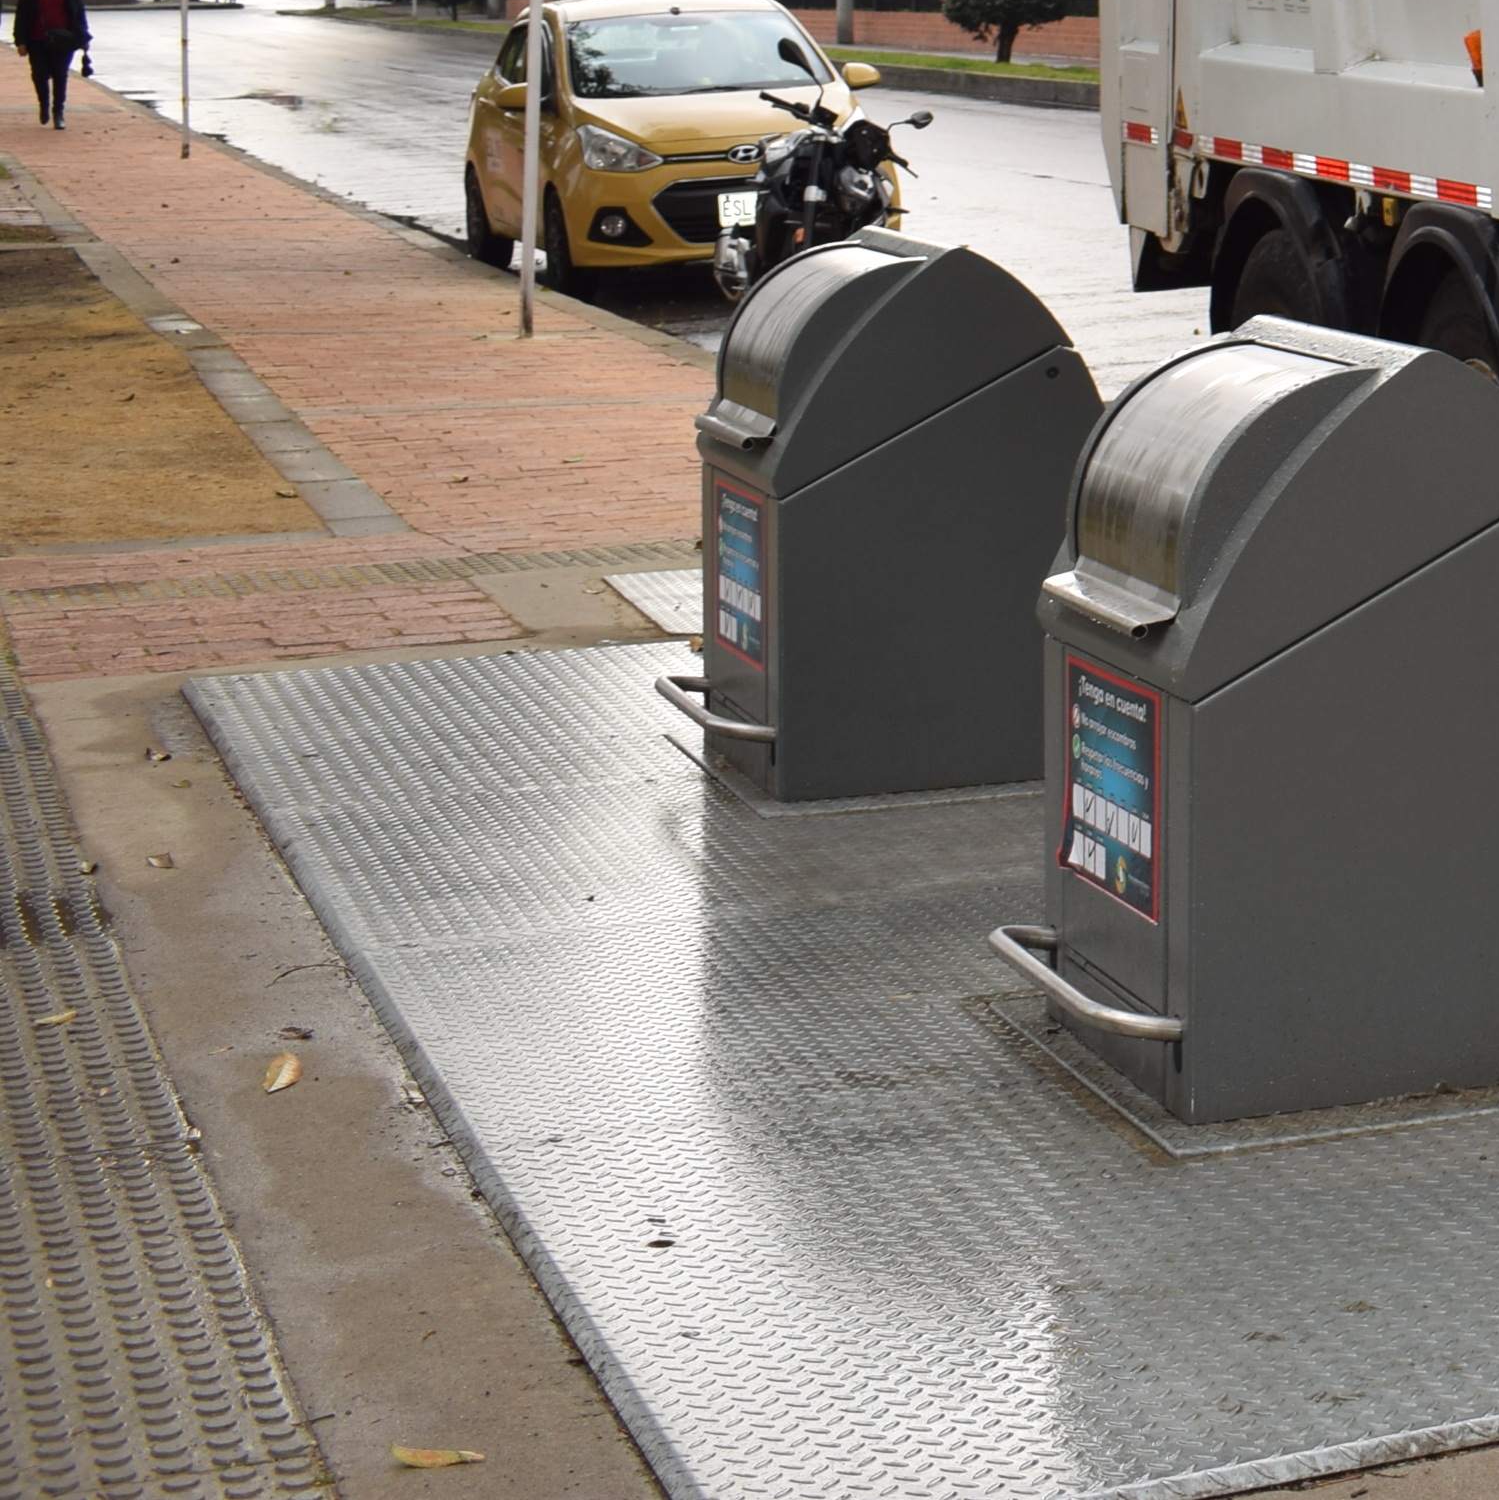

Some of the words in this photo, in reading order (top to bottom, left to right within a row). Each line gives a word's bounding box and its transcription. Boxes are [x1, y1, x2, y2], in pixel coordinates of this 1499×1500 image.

[723, 200, 751, 217] ESL
[1105, 692, 1115, 709] en
[1116, 697, 1146, 722] cuenta!
